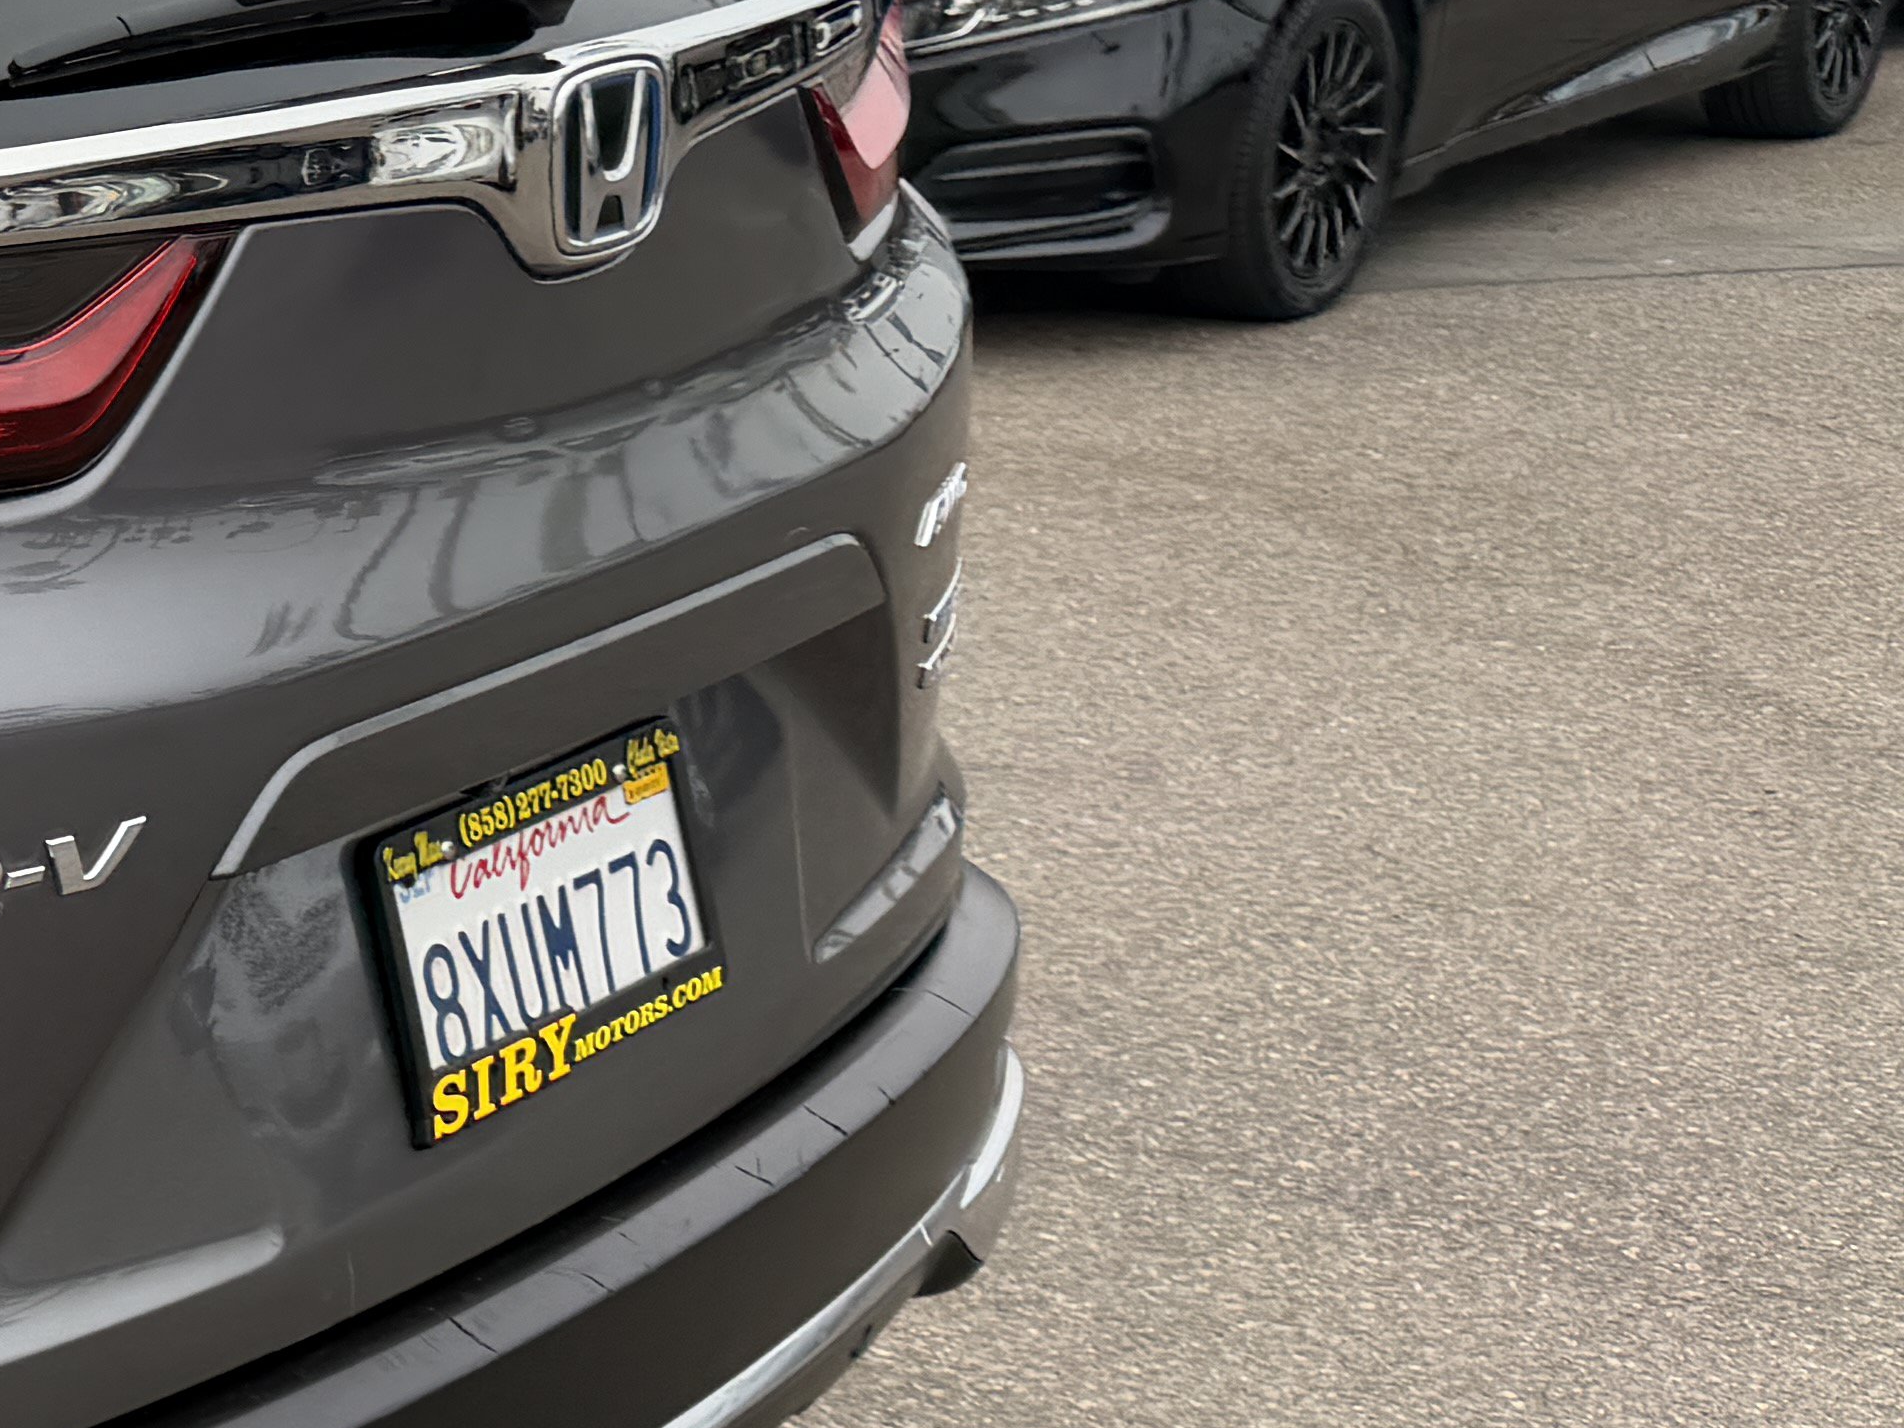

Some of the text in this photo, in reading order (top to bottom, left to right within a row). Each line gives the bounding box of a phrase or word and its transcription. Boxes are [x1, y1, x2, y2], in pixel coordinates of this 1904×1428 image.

[450, 795, 630, 899] California
[423, 838, 692, 1065] 8XUM773
[432, 965, 724, 1140] SIRY MOTORS.COM
